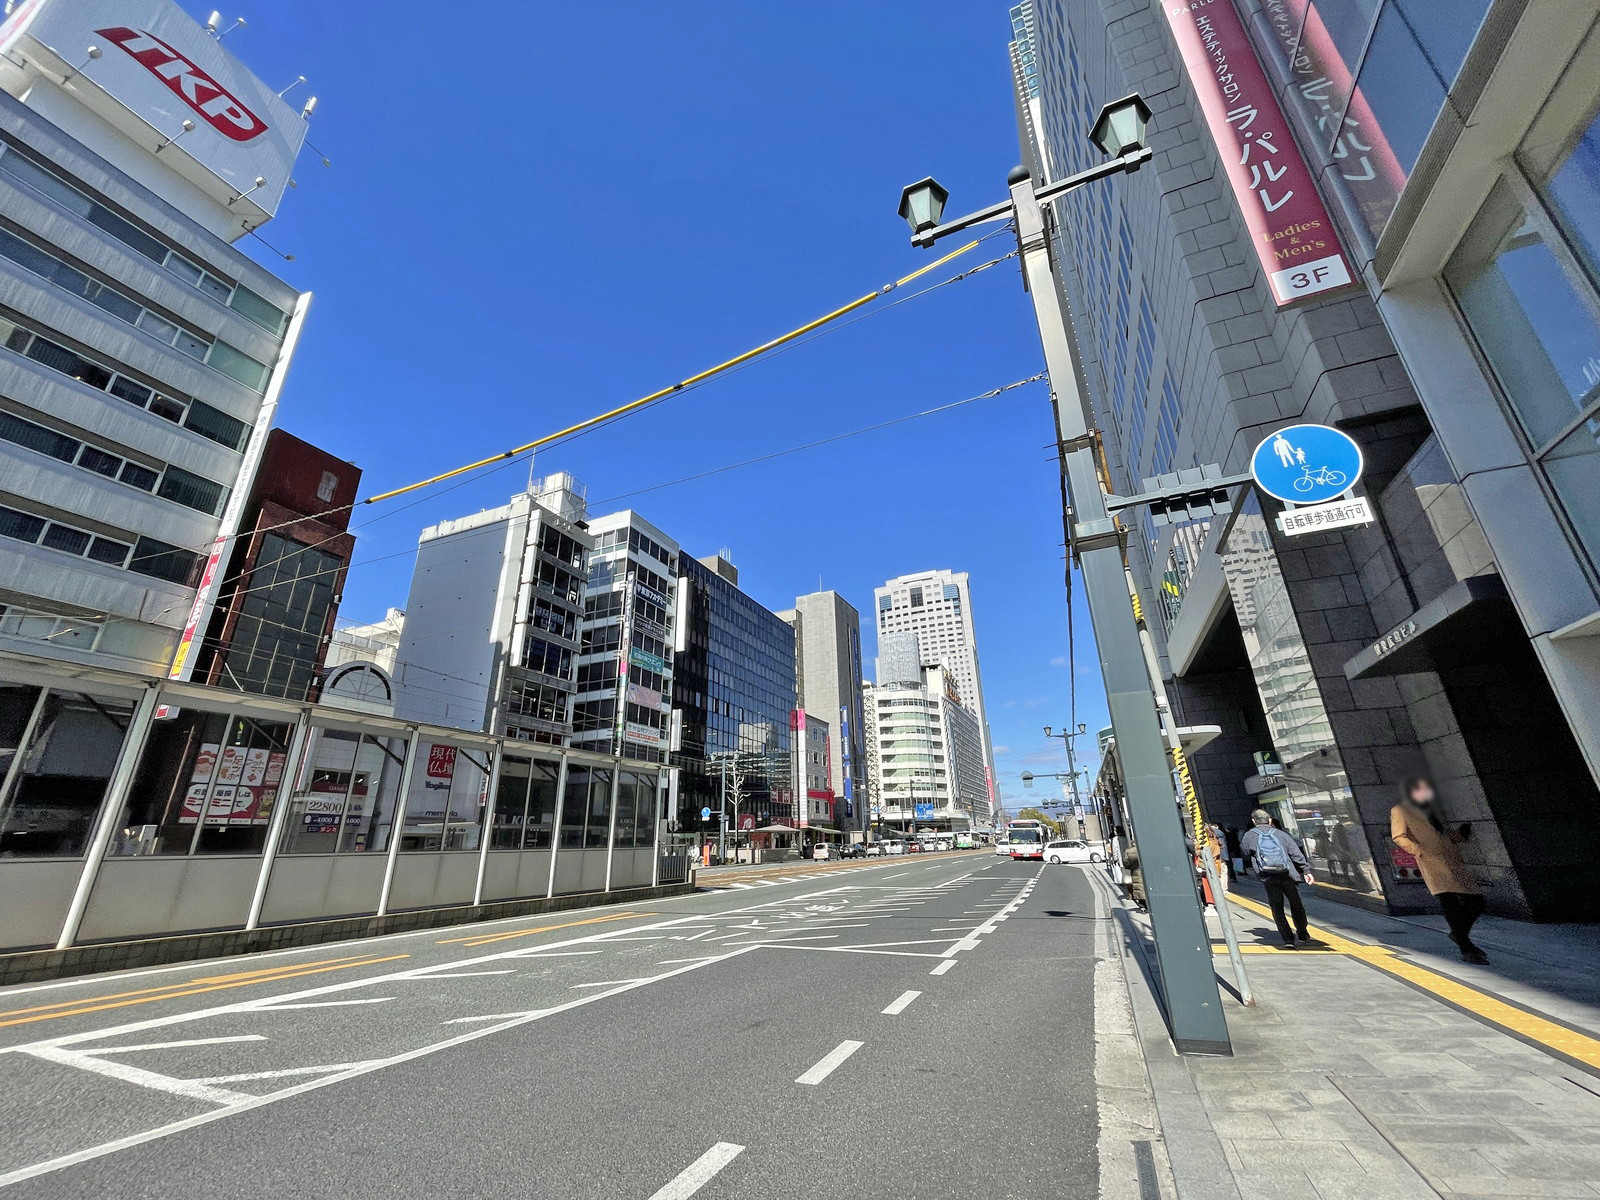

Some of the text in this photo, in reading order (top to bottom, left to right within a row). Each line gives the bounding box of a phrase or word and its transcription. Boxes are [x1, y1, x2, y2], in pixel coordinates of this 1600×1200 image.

[1196, 15, 1242, 104] エステティックサロン
[94, 26, 268, 142] TKP
[1226, 104, 1294, 213] ラ・パルレ
[1263, 219, 1321, 244] Ladies
[1289, 236, 1302, 246] &
[1273, 238, 1326, 262] Men's
[1290, 267, 1330, 289] 3F
[1284, 503, 1366, 530] 自転車歩道通行可
[431, 747, 456, 760] 現代
